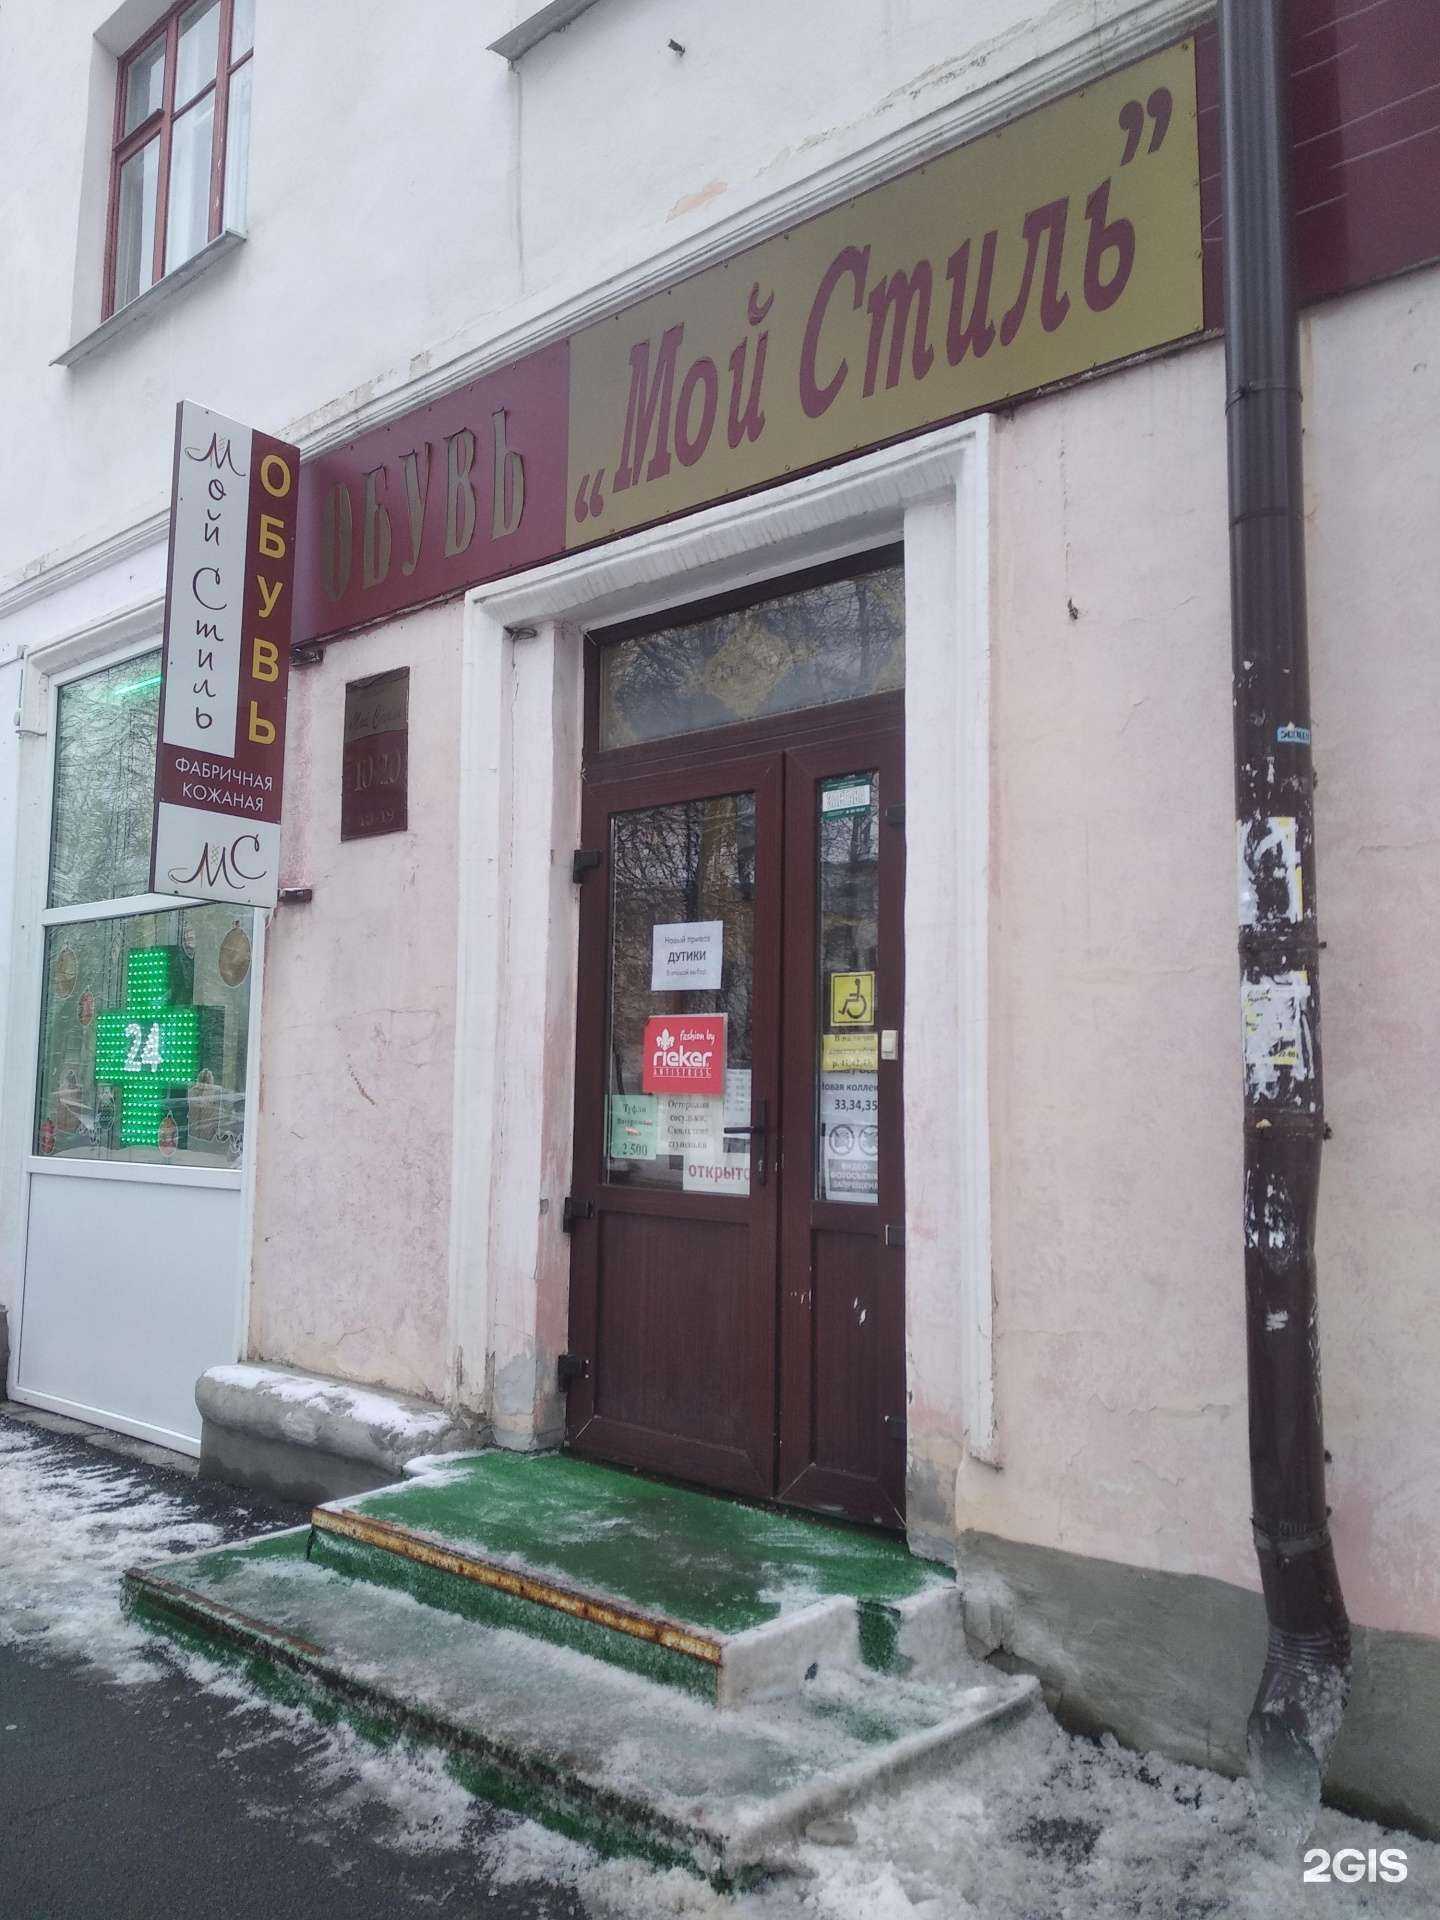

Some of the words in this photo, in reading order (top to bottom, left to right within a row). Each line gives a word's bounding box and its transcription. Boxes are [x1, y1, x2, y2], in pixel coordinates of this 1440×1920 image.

[185, 432, 246, 546] Мой
[320, 407, 525, 601] ОБУВЬ
[248, 454, 291, 745] ОБУВЬ
[192, 566, 227, 729] Стиль
[175, 757, 273, 791] ФАБРИЧНАЯ
[182, 782, 264, 812] КОЖАНАЯ
[168, 834, 267, 889] МС
[668, 950, 706, 965] ДУТИКИ
[124, 1023, 163, 1072] 24
[653, 1045, 712, 1067] rieker
[680, 1029, 704, 1041] fashion
[706, 1028, 715, 1045] by
